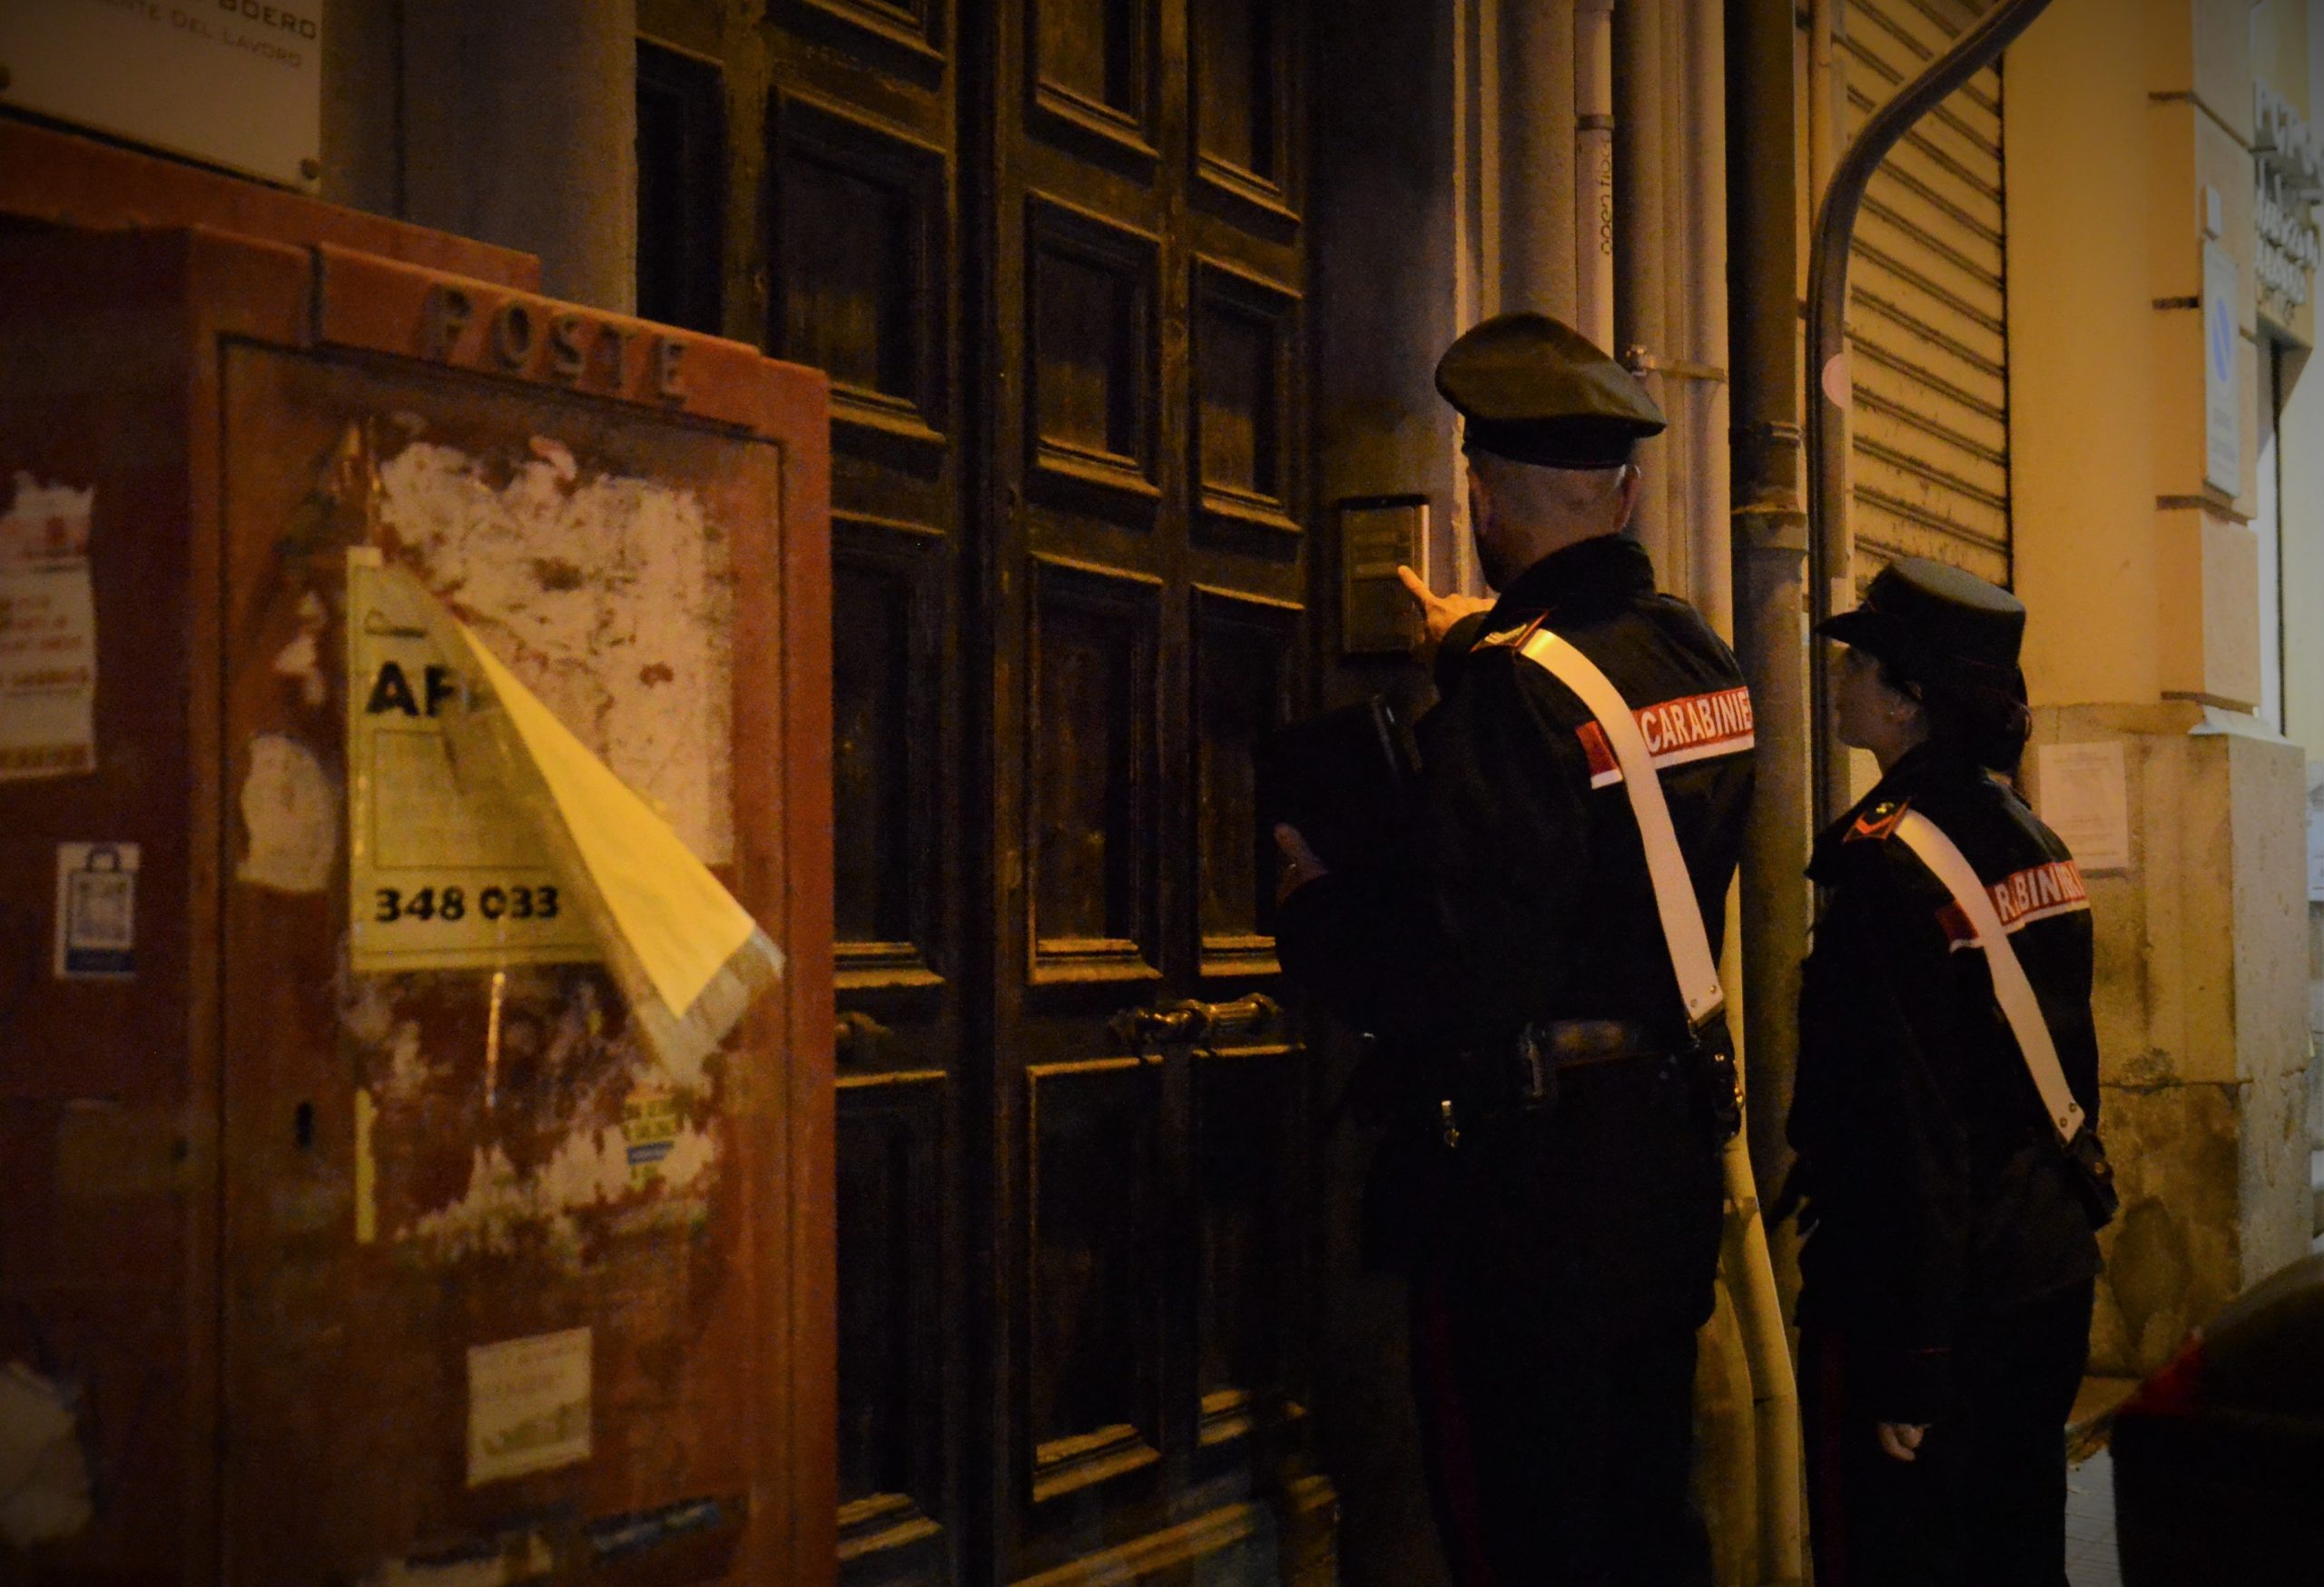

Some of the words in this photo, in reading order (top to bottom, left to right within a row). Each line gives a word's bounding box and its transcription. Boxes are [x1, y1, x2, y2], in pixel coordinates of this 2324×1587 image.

[425, 281, 687, 403] POSTE
[1640, 690, 1754, 753] CARABINIE
[374, 884, 466, 922] 348
[478, 884, 561, 922] 033
